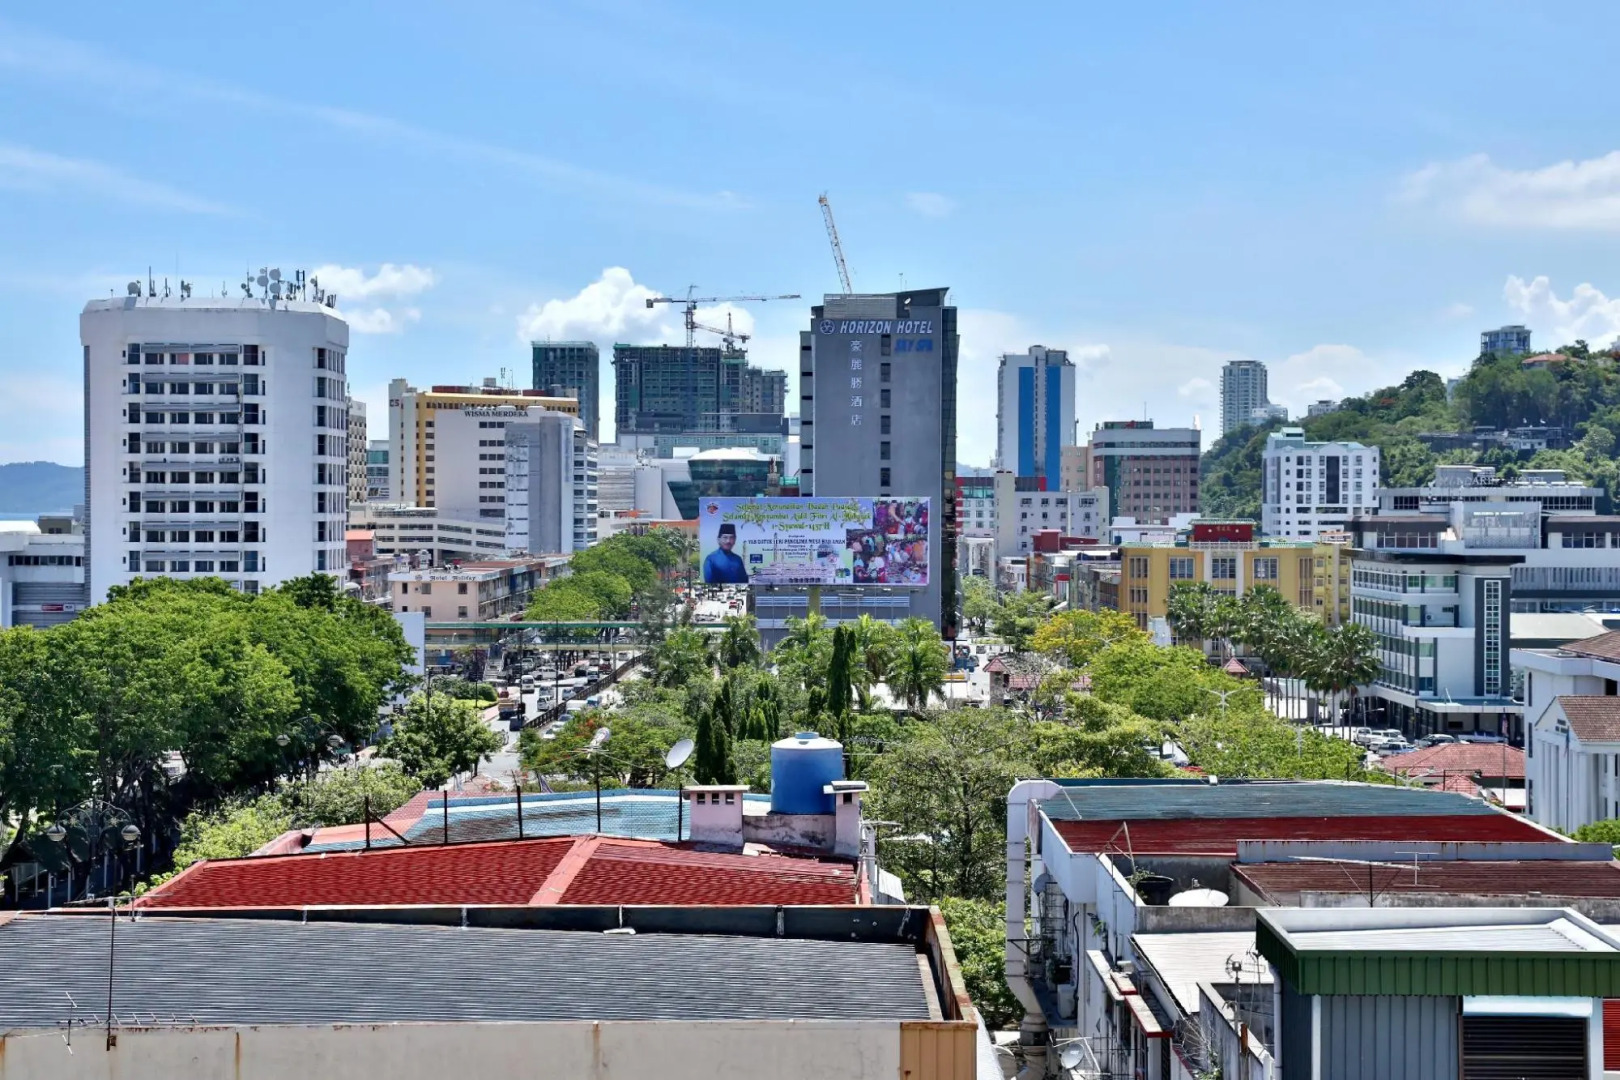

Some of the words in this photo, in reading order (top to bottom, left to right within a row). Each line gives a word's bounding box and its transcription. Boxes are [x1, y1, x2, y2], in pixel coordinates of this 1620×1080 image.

[840, 321, 891, 334] HORIZON
[897, 320, 933, 334] HOTEL
[1439, 476, 1499, 485] MANDARI
